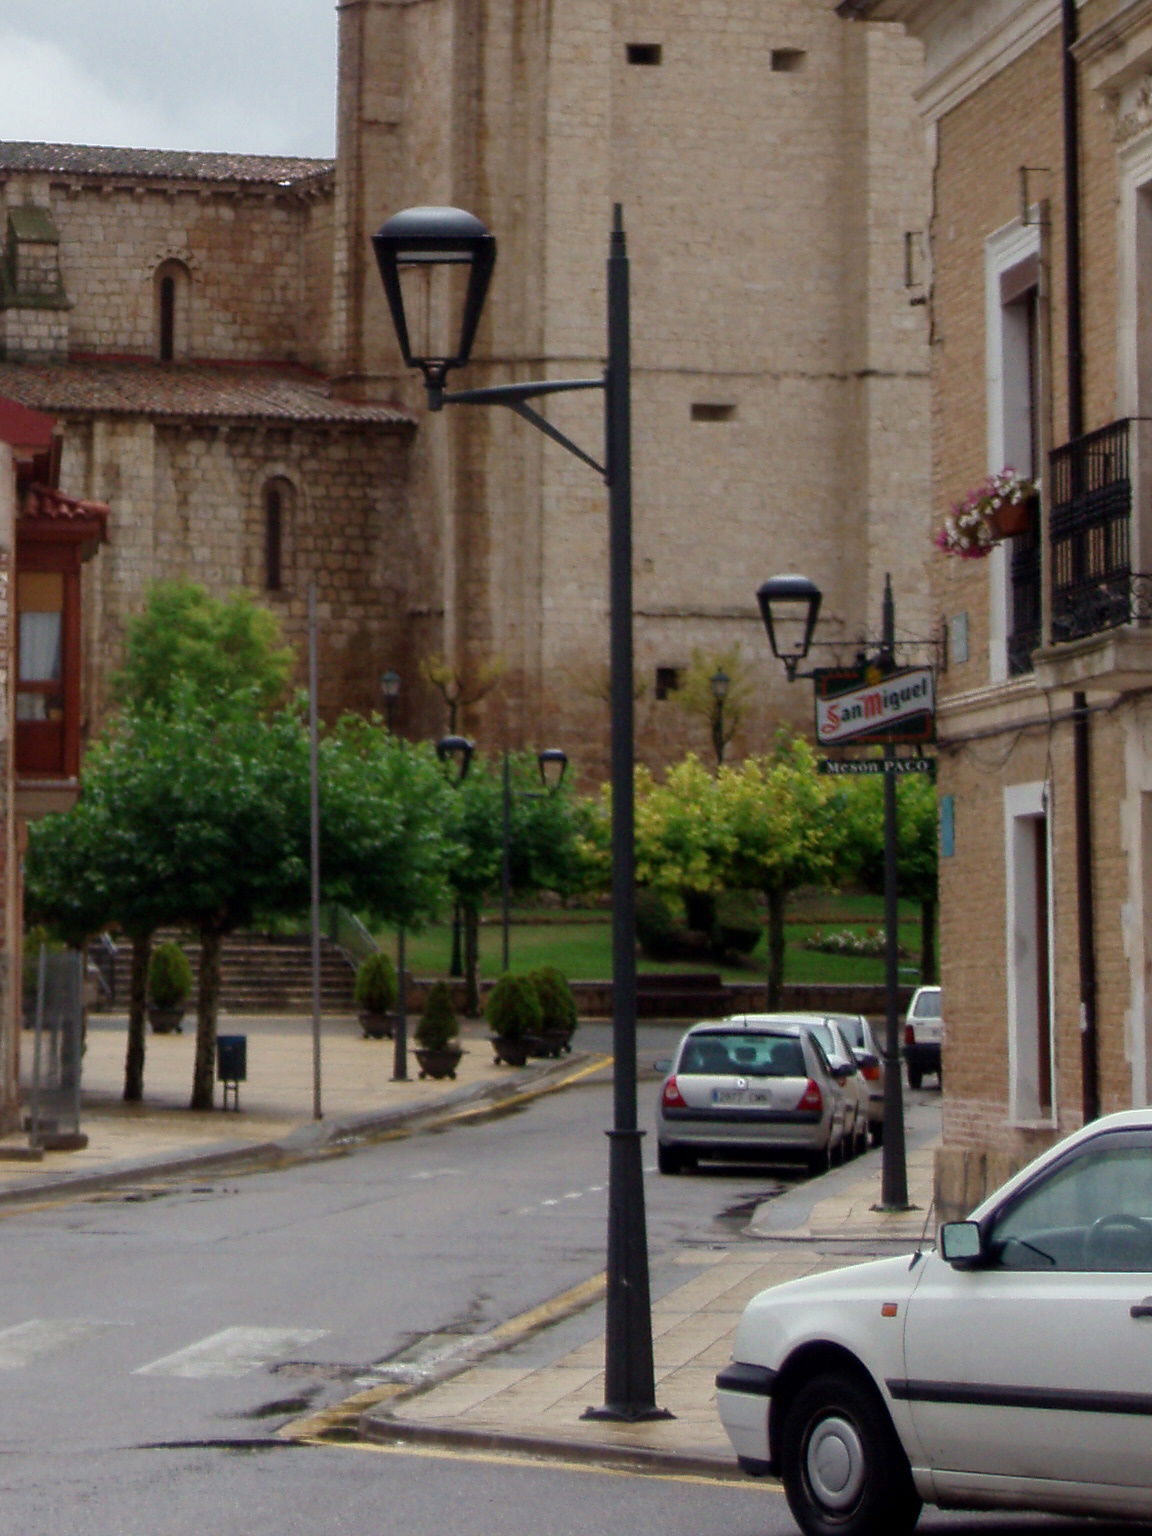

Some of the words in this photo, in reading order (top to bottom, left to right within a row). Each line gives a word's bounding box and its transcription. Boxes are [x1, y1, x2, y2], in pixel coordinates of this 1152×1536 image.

[821, 704, 862, 734] San
[856, 677, 928, 719] Miguel
[884, 760, 929, 773] PACO
